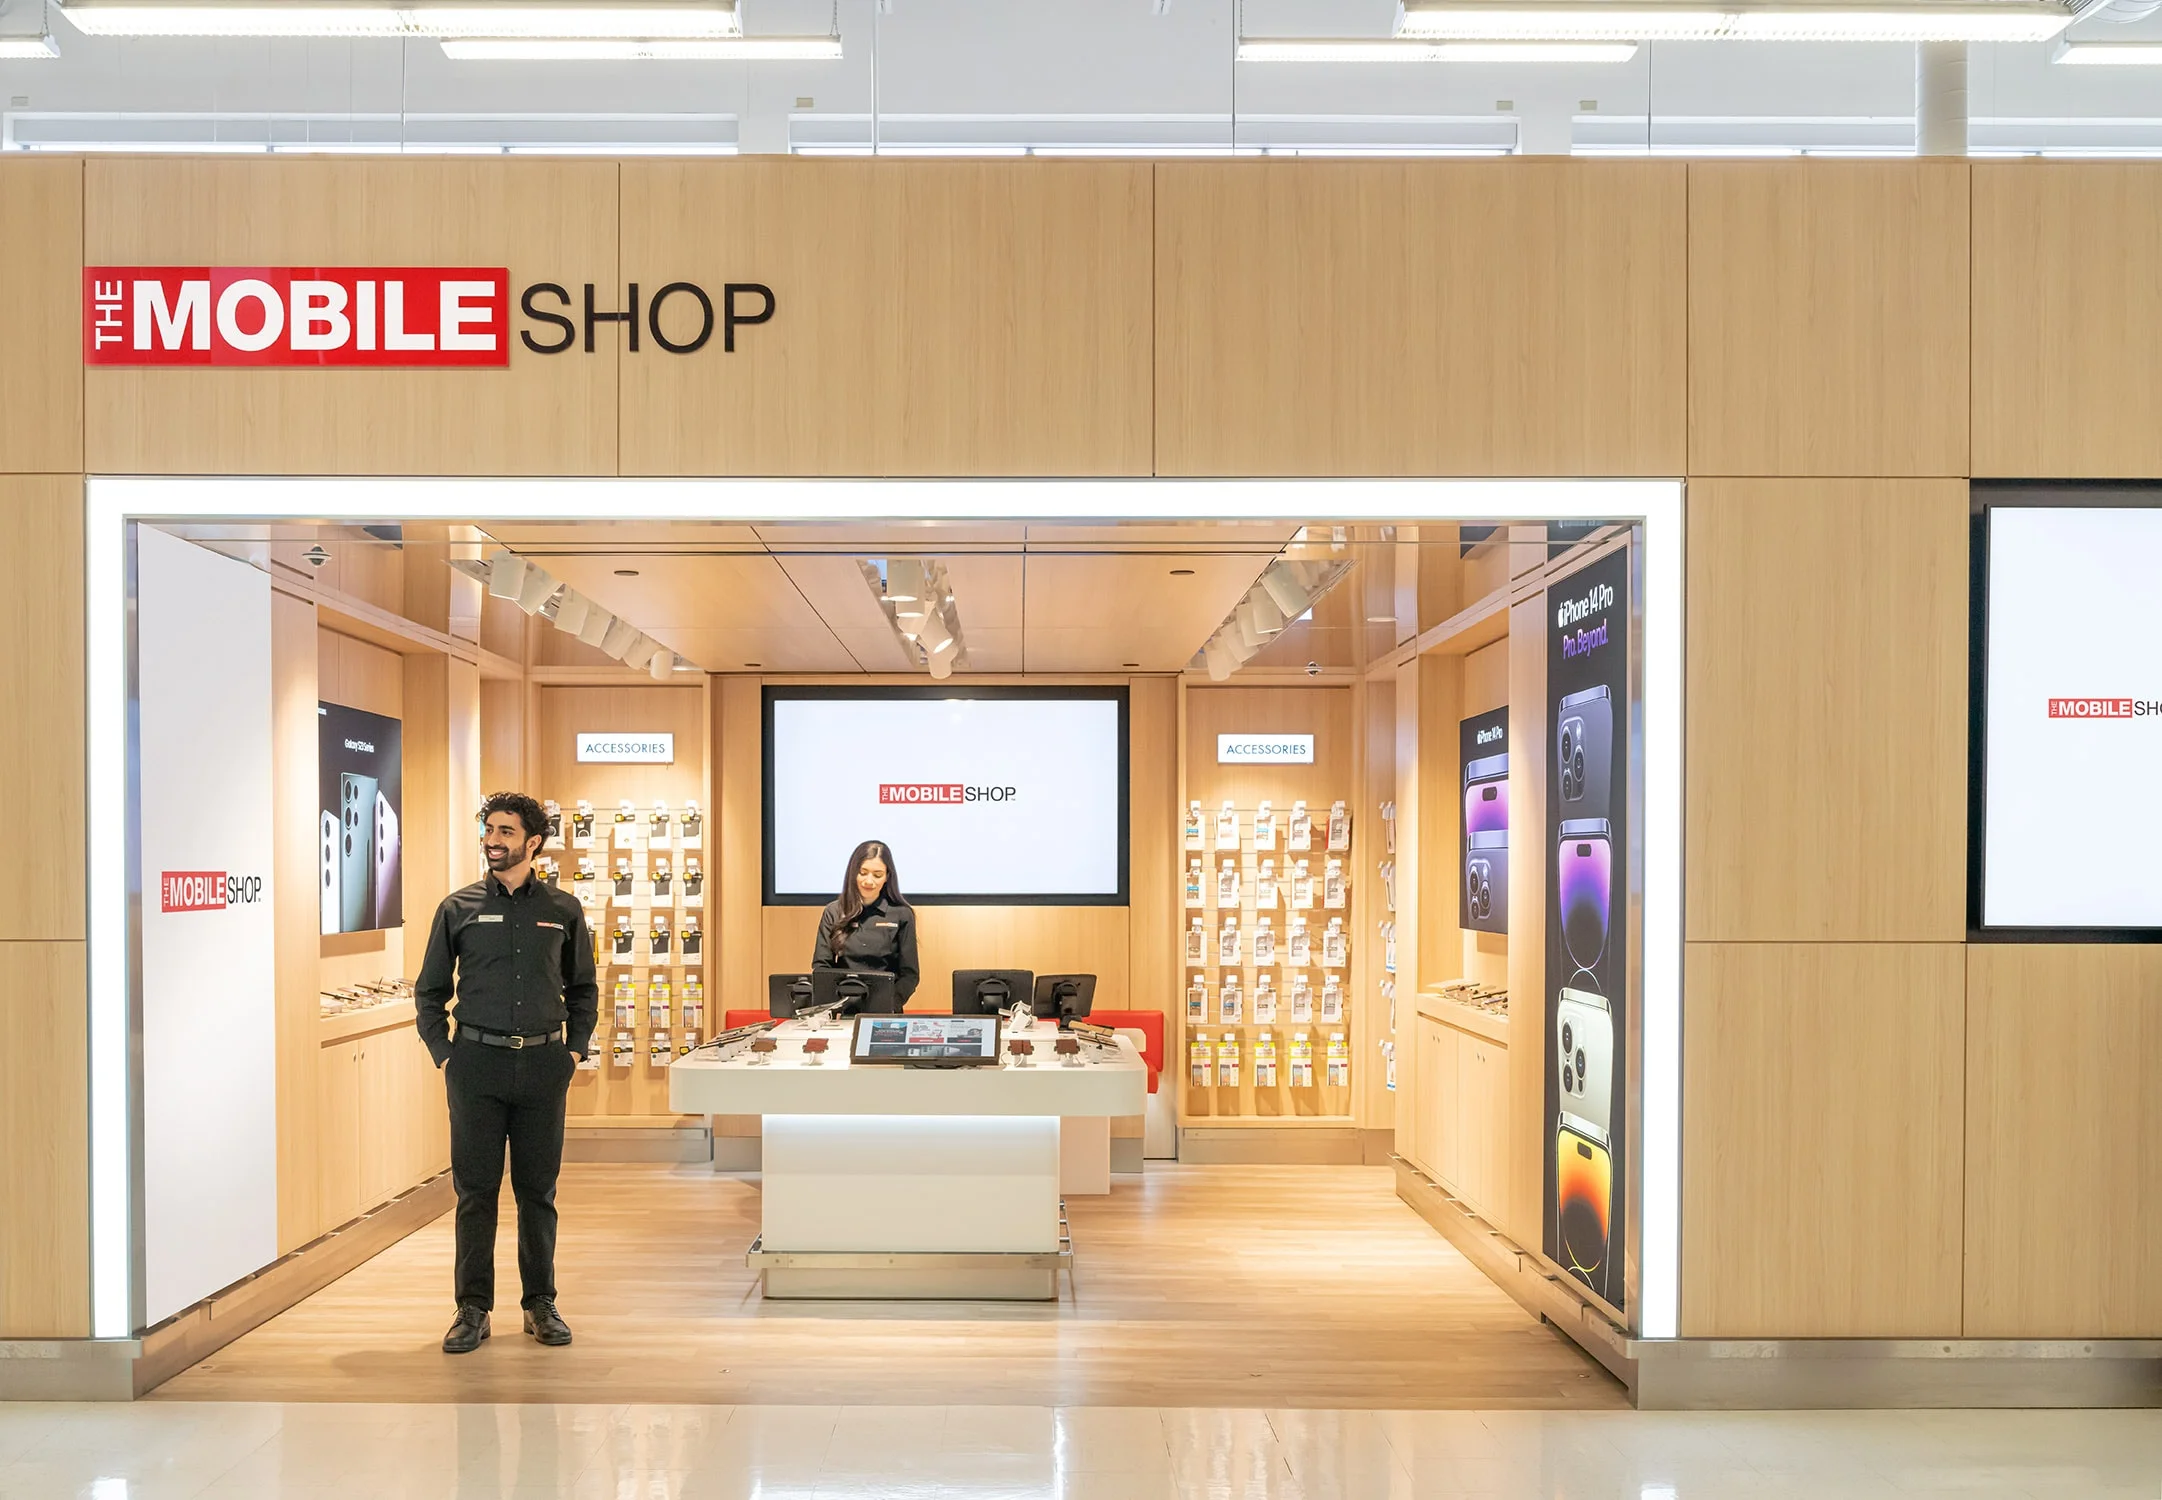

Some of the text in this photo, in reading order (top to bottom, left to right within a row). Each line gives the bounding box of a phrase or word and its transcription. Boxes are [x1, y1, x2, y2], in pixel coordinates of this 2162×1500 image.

[95, 278, 777, 354] THE MOBILE SHOP
[1563, 583, 1614, 626] iPhone 14 Pro
[1563, 618, 1609, 660] Pro. Beyond.
[2059, 700, 2131, 716] MOBILE
[2134, 700, 2162, 716] SH
[585, 743, 666, 754] ACCESSORIES
[1226, 744, 1306, 755] ACCESSORIES
[889, 786, 962, 802] MOBILE
[965, 786, 1016, 802] SHOP
[169, 876, 225, 907] MOBILE
[227, 876, 262, 904] SHOP
